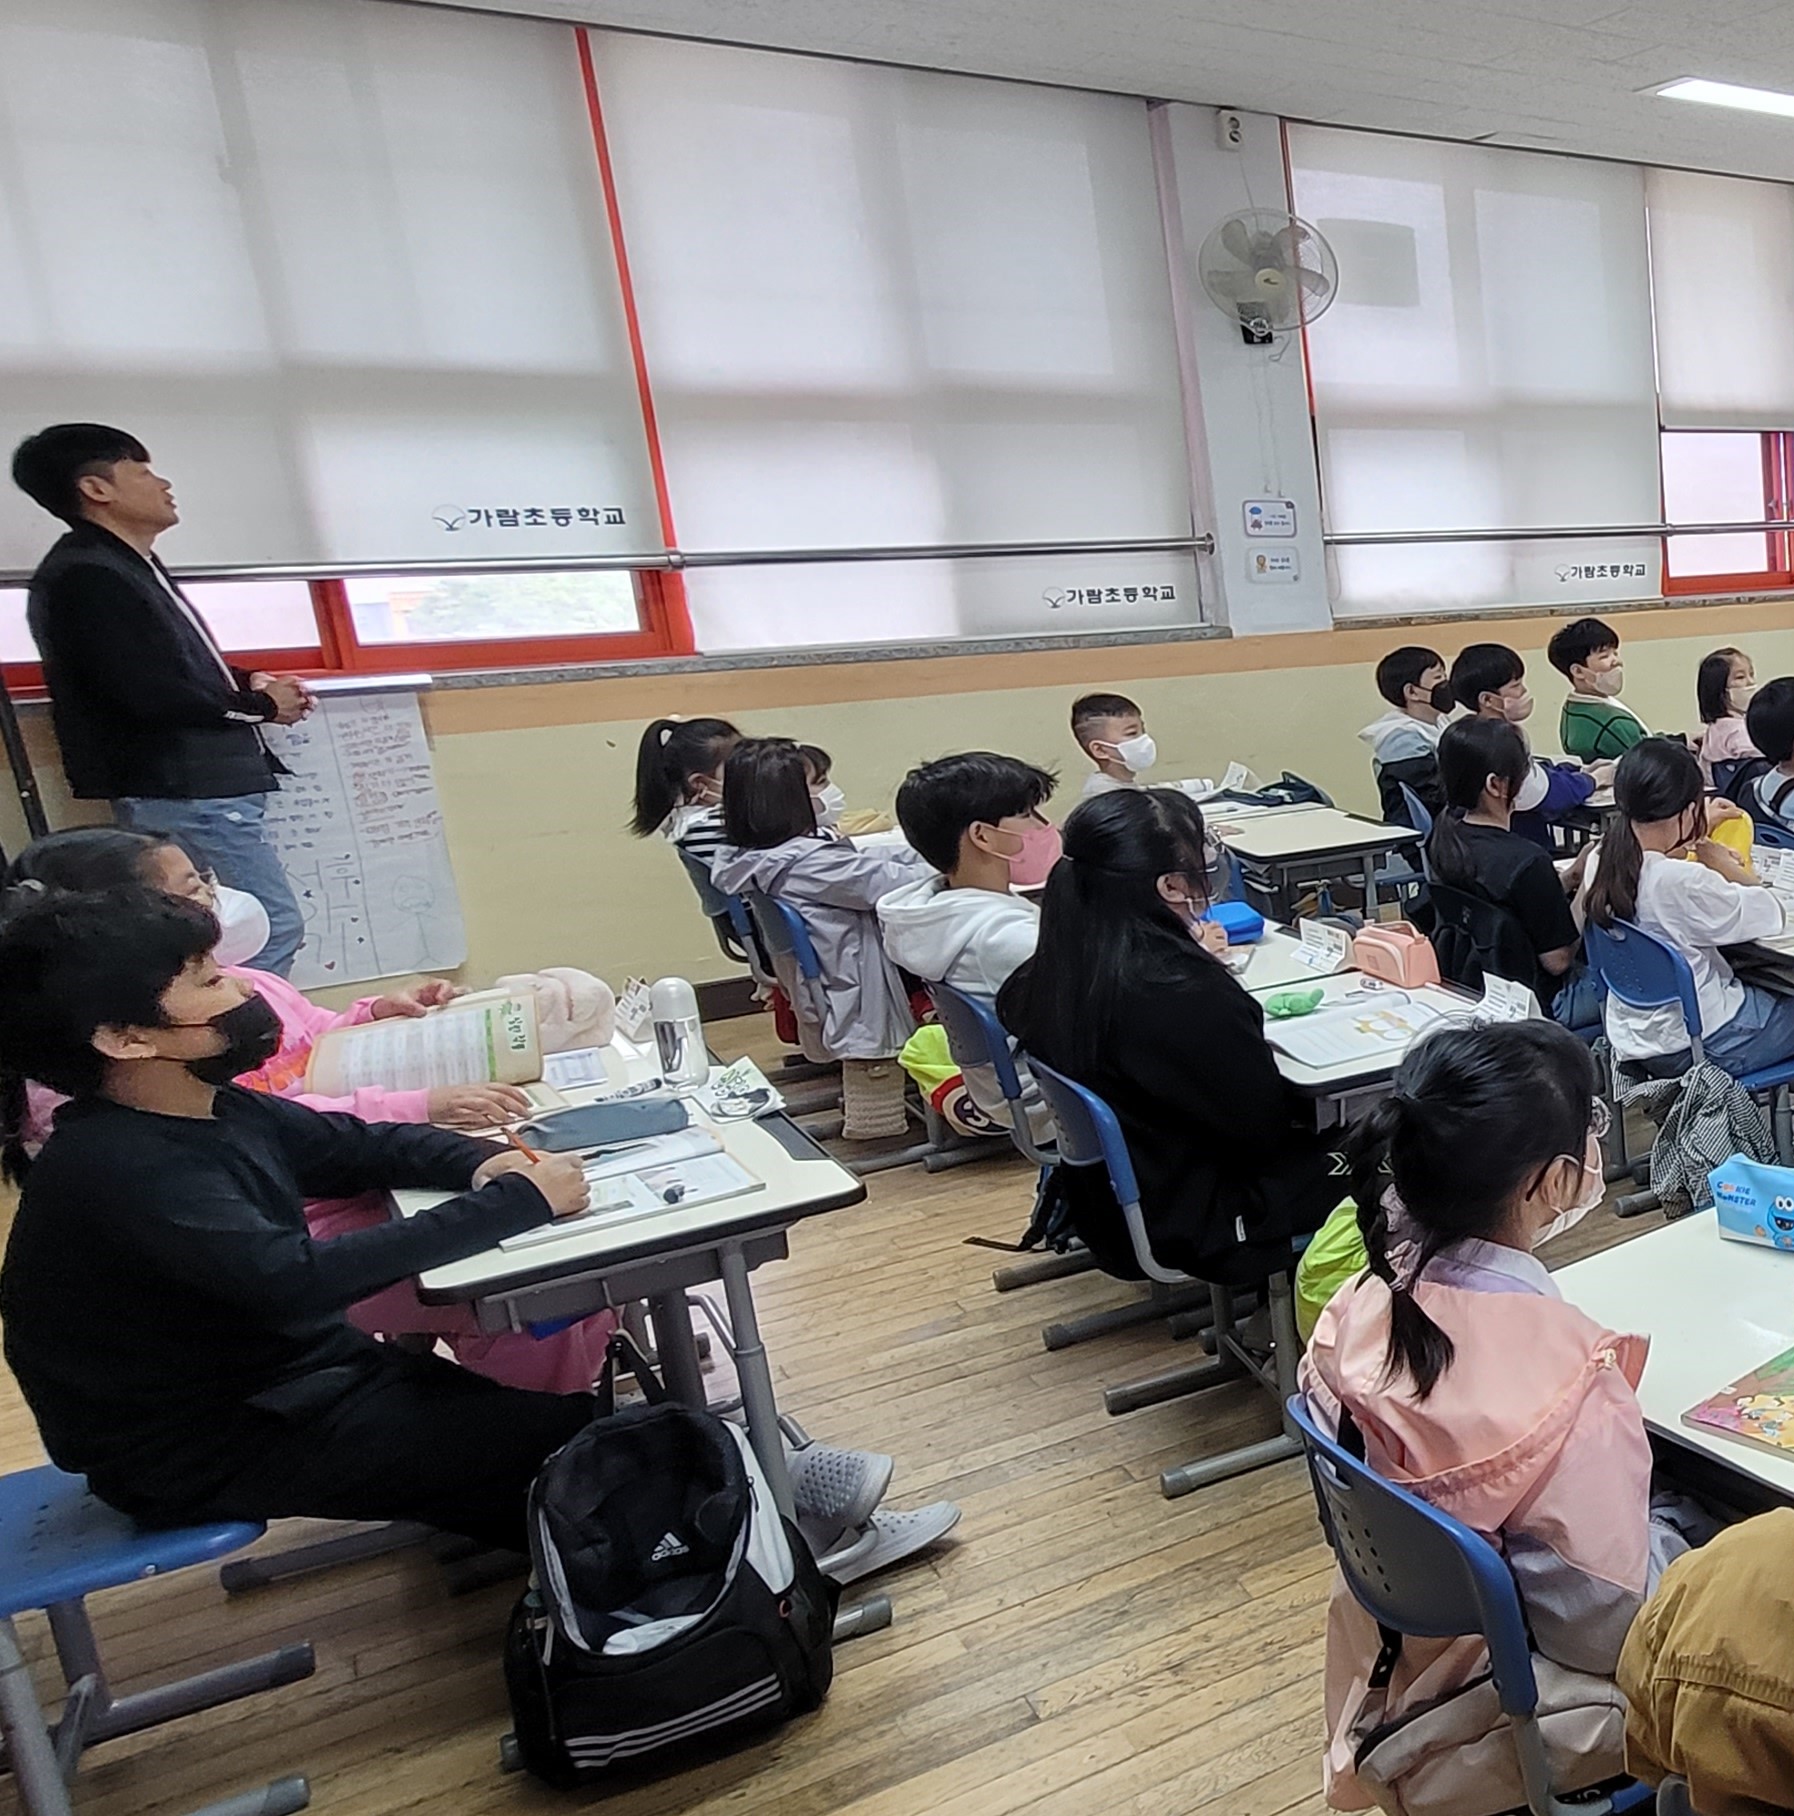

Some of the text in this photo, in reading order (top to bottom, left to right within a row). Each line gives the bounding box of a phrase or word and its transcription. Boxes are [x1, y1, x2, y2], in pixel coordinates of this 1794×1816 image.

[467, 507, 626, 527] 가람초등학교
[1571, 564, 1646, 579] 가람초등학교
[1066, 585, 1176, 605] 가람초등학교
[1717, 1181, 1751, 1195] COOKIE
[1717, 1191, 1757, 1206] MONSTER
